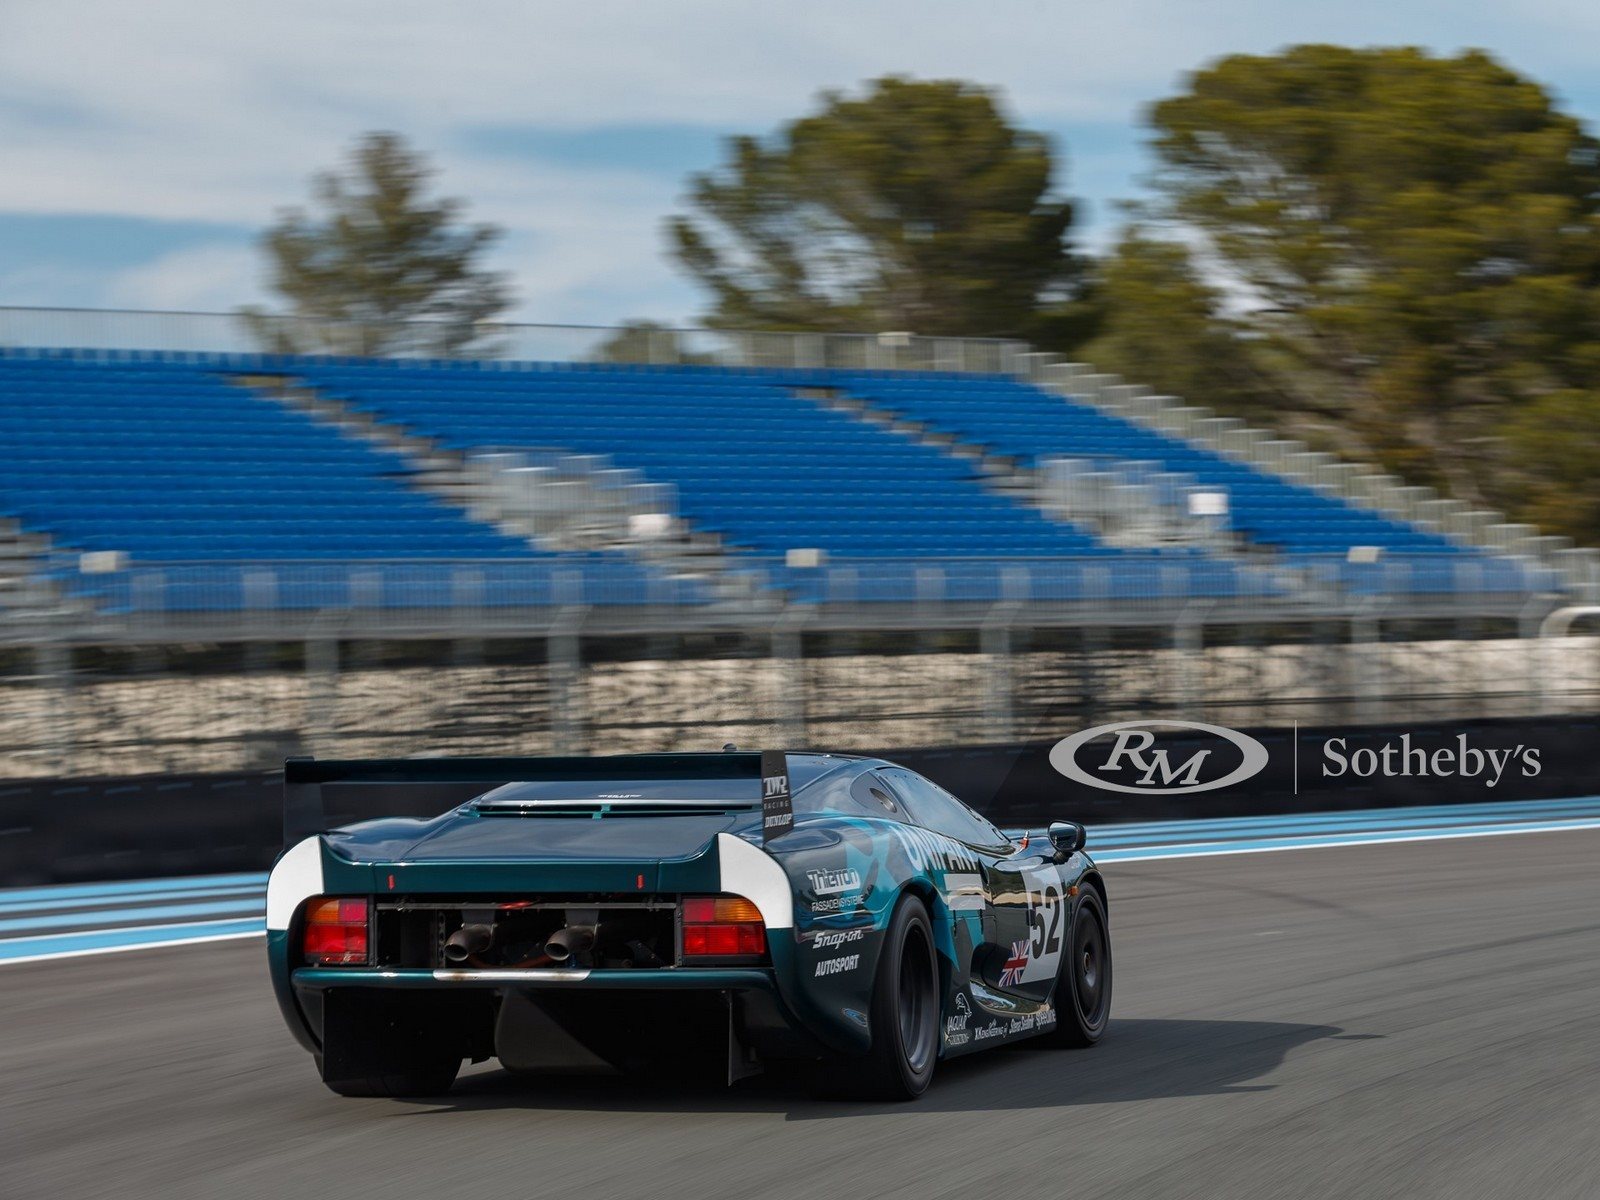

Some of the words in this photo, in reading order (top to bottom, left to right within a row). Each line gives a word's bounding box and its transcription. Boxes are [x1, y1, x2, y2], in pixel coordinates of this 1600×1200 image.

[763, 775, 788, 796] TWR
[764, 813, 792, 828] DUNLOP
[1030, 885, 1061, 960] 52
[812, 929, 864, 950] Snap-on
[814, 953, 860, 978] AUTOSPORT
[947, 1014, 967, 1035] JAGUAR
